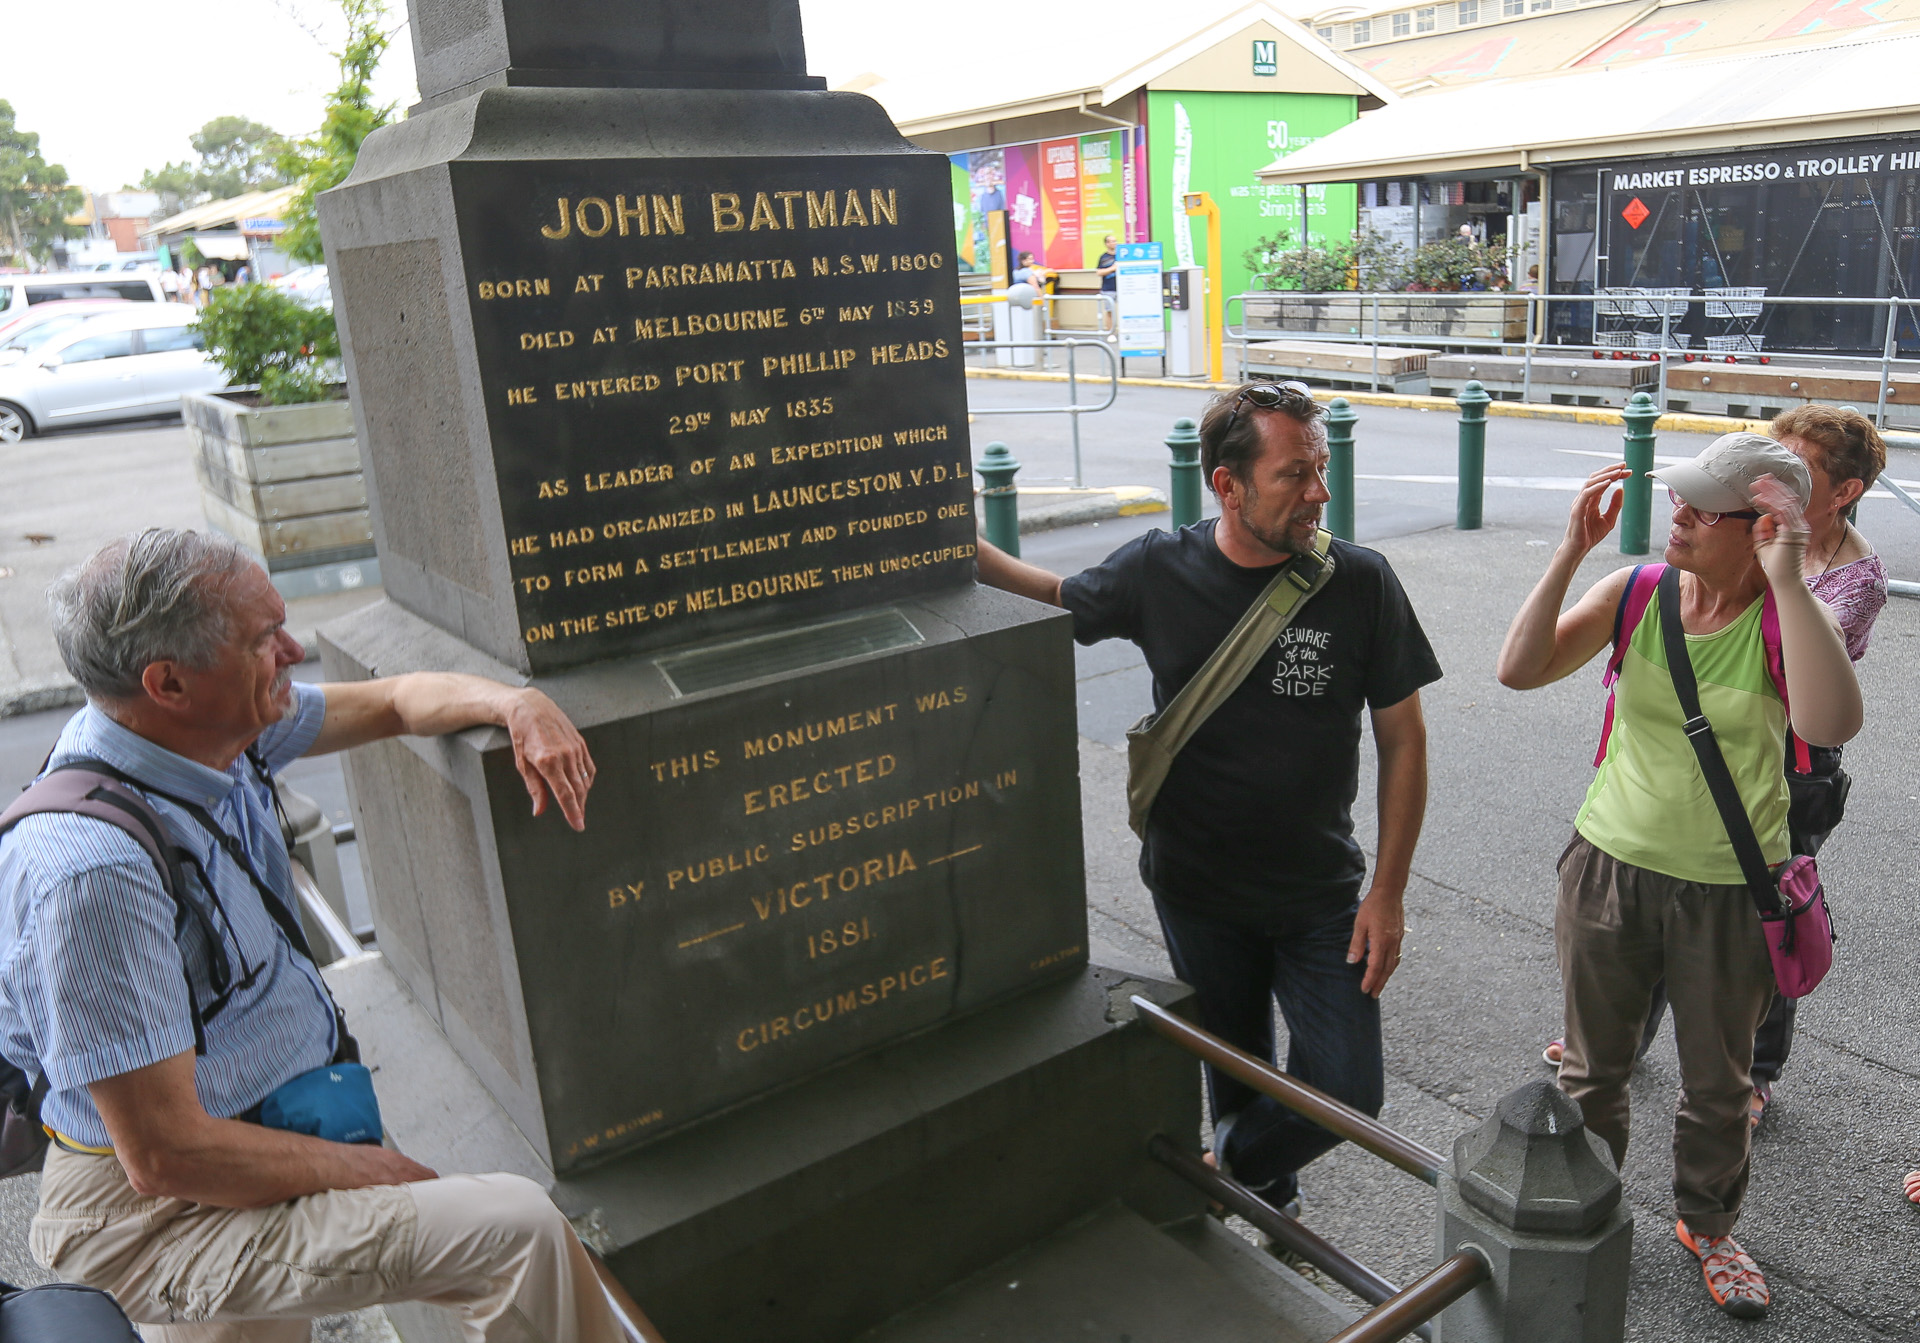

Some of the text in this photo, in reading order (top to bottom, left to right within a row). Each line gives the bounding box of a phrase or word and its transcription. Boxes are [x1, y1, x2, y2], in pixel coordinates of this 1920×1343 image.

[1254, 41, 1275, 64] M
[1267, 120, 1288, 149] 50
[1613, 170, 1684, 191] MARKET
[1688, 162, 1781, 186] ESPRESSO
[1784, 166, 1795, 179] &
[1797, 154, 1885, 178] TROLLEY
[541, 189, 897, 239] JOHN BATMAN
[1259, 200, 1293, 221] String
[478, 278, 550, 299] BORN
[576, 275, 604, 293] AT
[626, 260, 797, 288] PARRAMATTA
[521, 331, 575, 350] DIED
[593, 327, 617, 344] AT
[635, 308, 788, 340] MELBOURNE
[840, 306, 874, 322] MAY
[888, 299, 934, 317] 1839
[508, 339, 949, 406] HE ENTERED PORT PHILLIP HEADS
[730, 408, 770, 427] MAY
[787, 397, 834, 418] 1835
[539, 426, 947, 498] AS LEADER OF AN EXPEDITION WHICH
[512, 536, 541, 556] HE
[550, 527, 595, 548] HAD
[726, 502, 744, 518] IN
[520, 504, 968, 594] TO FORM A SETTLEMENT AND FOUNDED ONE
[526, 544, 976, 643] ON THE SITE OF MELBOURNE THEN UNOCCUPIED
[1277, 661, 1332, 680] DARK
[1285, 645, 1319, 663] of the
[1272, 679, 1327, 696] SIDE
[650, 687, 968, 781] THIS MONUMENT WAS
[744, 754, 896, 816] ERECTED
[608, 770, 1016, 907] BY PUBLIC SUBSCRIPTION IN
[752, 849, 917, 920] VICTORIA
[737, 957, 948, 1051] CIRCUMSPICE
